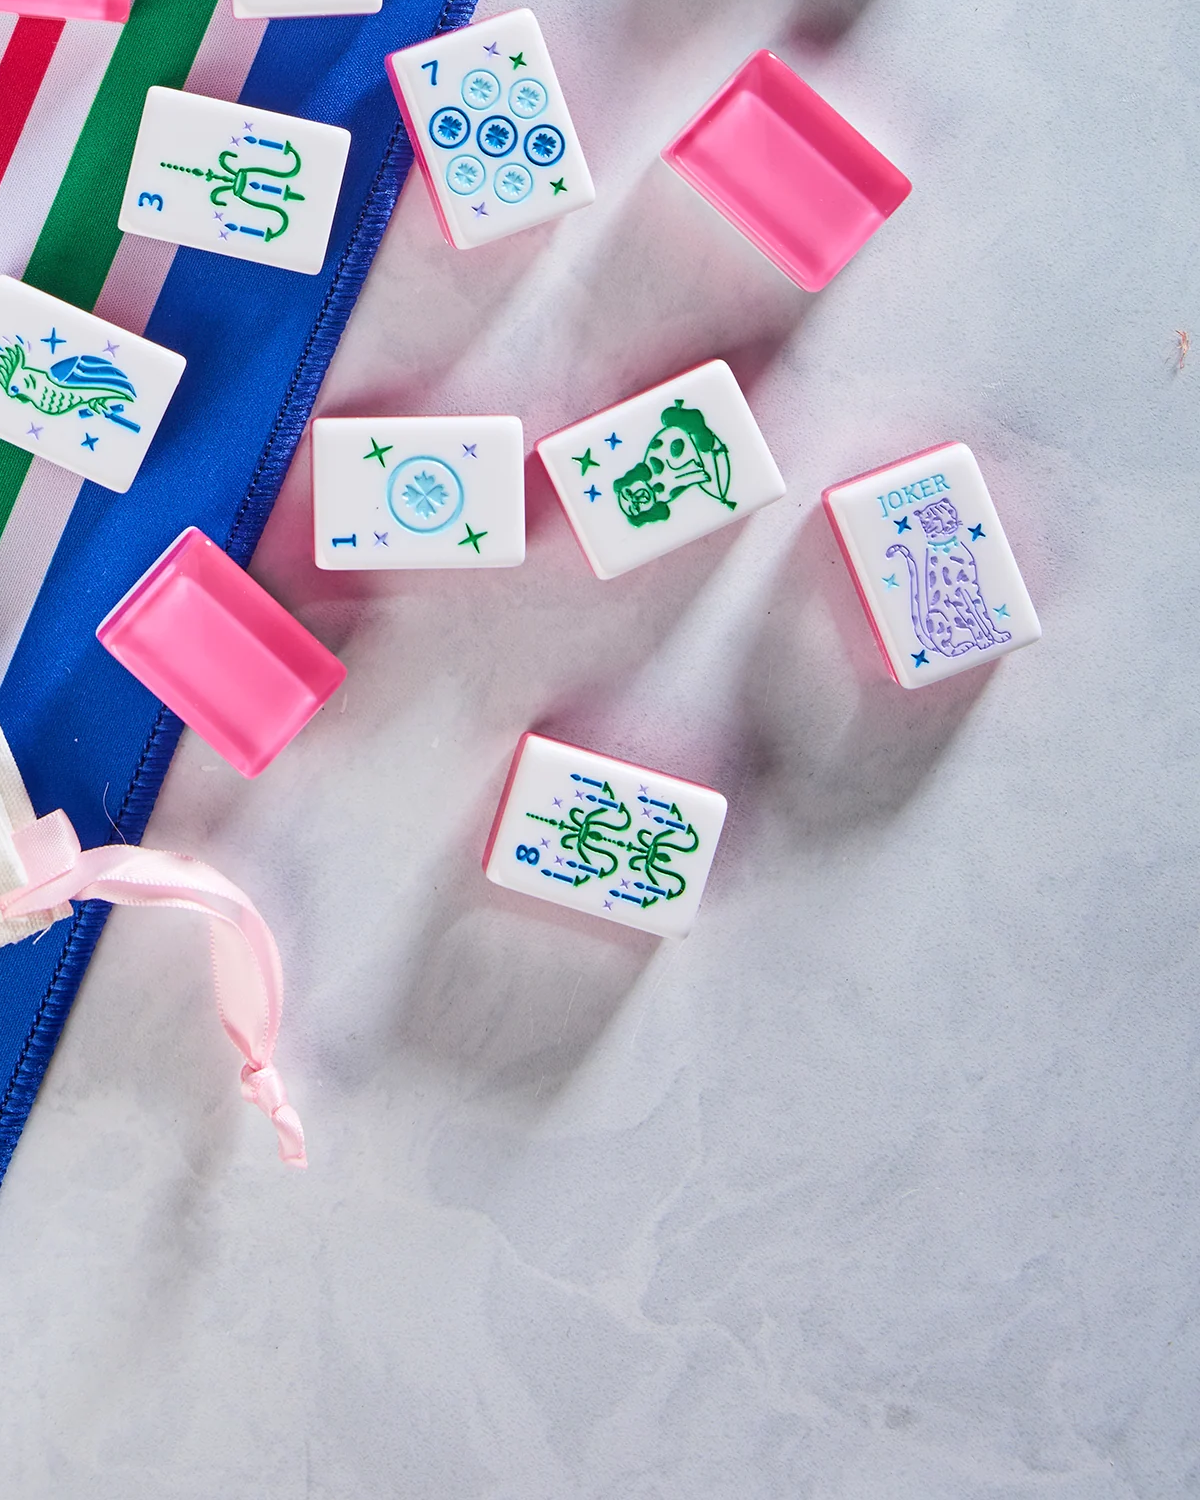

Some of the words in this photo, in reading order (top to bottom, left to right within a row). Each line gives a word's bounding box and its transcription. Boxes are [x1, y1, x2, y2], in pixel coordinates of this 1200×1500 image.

[421, 60, 438, 86] 7
[138, 192, 163, 211] 3
[877, 474, 951, 518] JOKER
[332, 534, 356, 547] 1
[516, 845, 540, 865] 8
